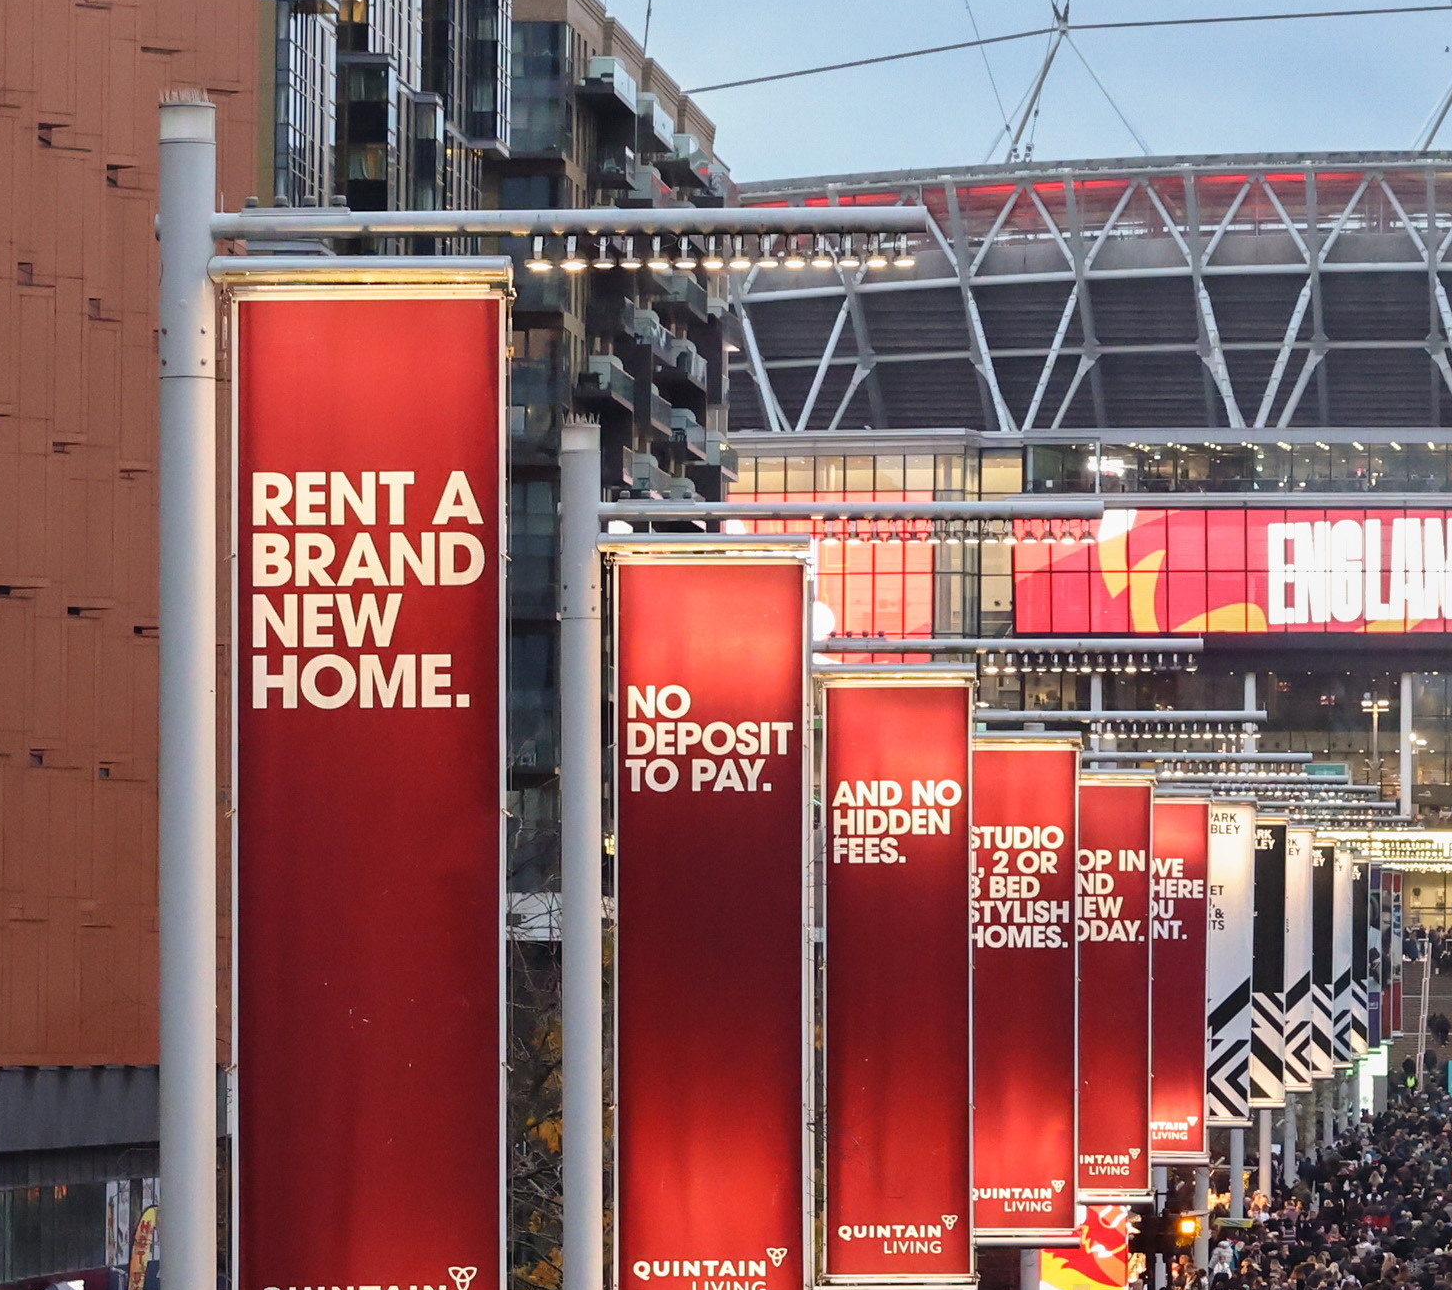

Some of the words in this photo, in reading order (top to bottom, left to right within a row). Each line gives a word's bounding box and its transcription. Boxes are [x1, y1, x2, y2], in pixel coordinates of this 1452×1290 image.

[253, 471, 414, 526] RENT
[432, 471, 484, 525] A
[253, 532, 484, 587] BRAND
[253, 593, 402, 648] NEW
[253, 654, 470, 709] HOME.
[628, 685, 691, 719] NO
[627, 722, 794, 756] DEPOSIT
[626, 759, 678, 793] TO
[692, 759, 772, 793] PAY.
[832, 781, 902, 808] AND
[912, 781, 963, 808] NO
[833, 809, 951, 836] HIDDEN
[971, 826, 1065, 850] STUDIO
[833, 837, 907, 864] FEES.
[1119, 850, 1146, 872] IN
[992, 852, 1010, 875] 2
[1016, 852, 1058, 875] OR
[990, 876, 1041, 899] BED
[971, 900, 1070, 924] STYLISH
[971, 925, 1069, 949] HOMES.
[1089, 1164, 1130, 1176] LIVING
[1004, 1199, 1053, 1213] LIVING
[838, 1225, 942, 1242] QUINTAIN
[884, 1241, 942, 1255] LIVING
[633, 1261, 767, 1281] QUINTAIN
